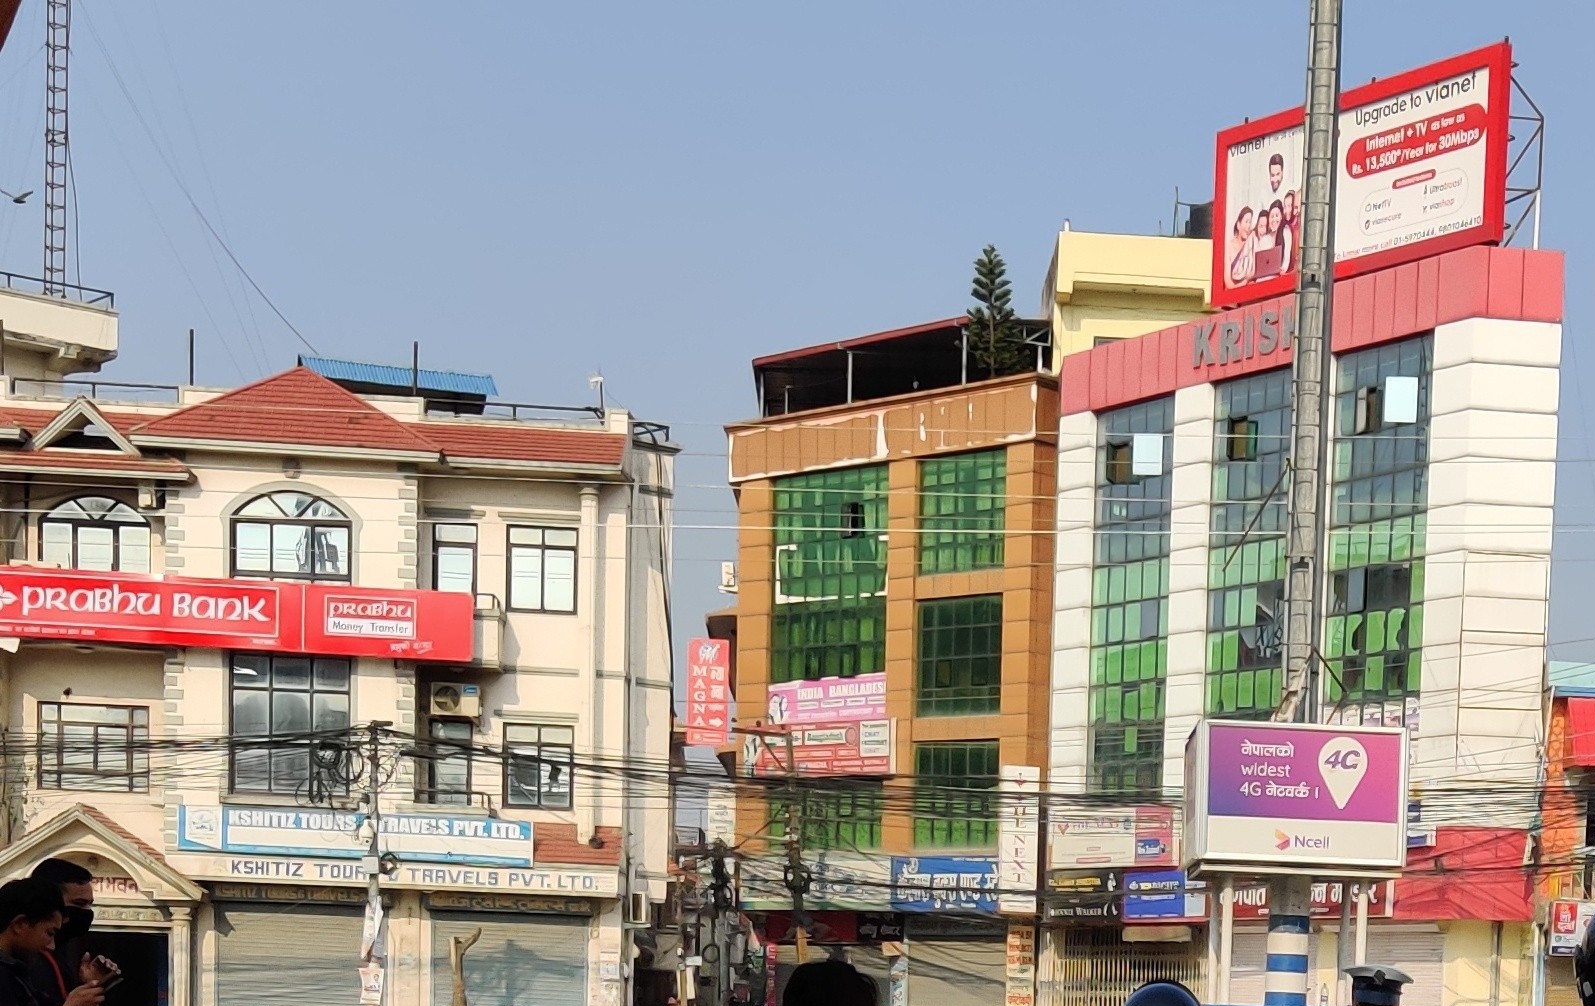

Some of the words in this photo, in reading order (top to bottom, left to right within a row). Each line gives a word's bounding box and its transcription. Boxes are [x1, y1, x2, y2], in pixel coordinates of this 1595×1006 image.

[1355, 98, 1408, 127] Upgrade
[1411, 92, 1422, 110] to
[1425, 71, 1477, 104] vianet
[1415, 120, 1429, 139] TV
[1438, 126, 1480, 151] 30Mbps
[332, 620, 363, 634] Money
[370, 622, 409, 634] Transfer
[692, 664, 708, 728] MAGNA
[797, 687, 824, 700] INDIA
[829, 681, 886, 698] BANGLADES
[1241, 739, 1295, 758] नेपालको
[1241, 763, 1290, 778] widest
[1239, 782, 1262, 797] 4G
[1265, 780, 1311, 799] नेटवर्क
[229, 809, 296, 828] KSHITIZ
[299, 813, 357, 831] TOURS
[453, 821, 488, 837] PVT.
[491, 823, 525, 840] LTD.
[1294, 835, 1330, 850] Ncell
[231, 859, 304, 877] KSHITIZ
[314, 863, 366, 881] TOUR
[407, 867, 498, 886] TRAVELS
[508, 872, 551, 888] PVT.
